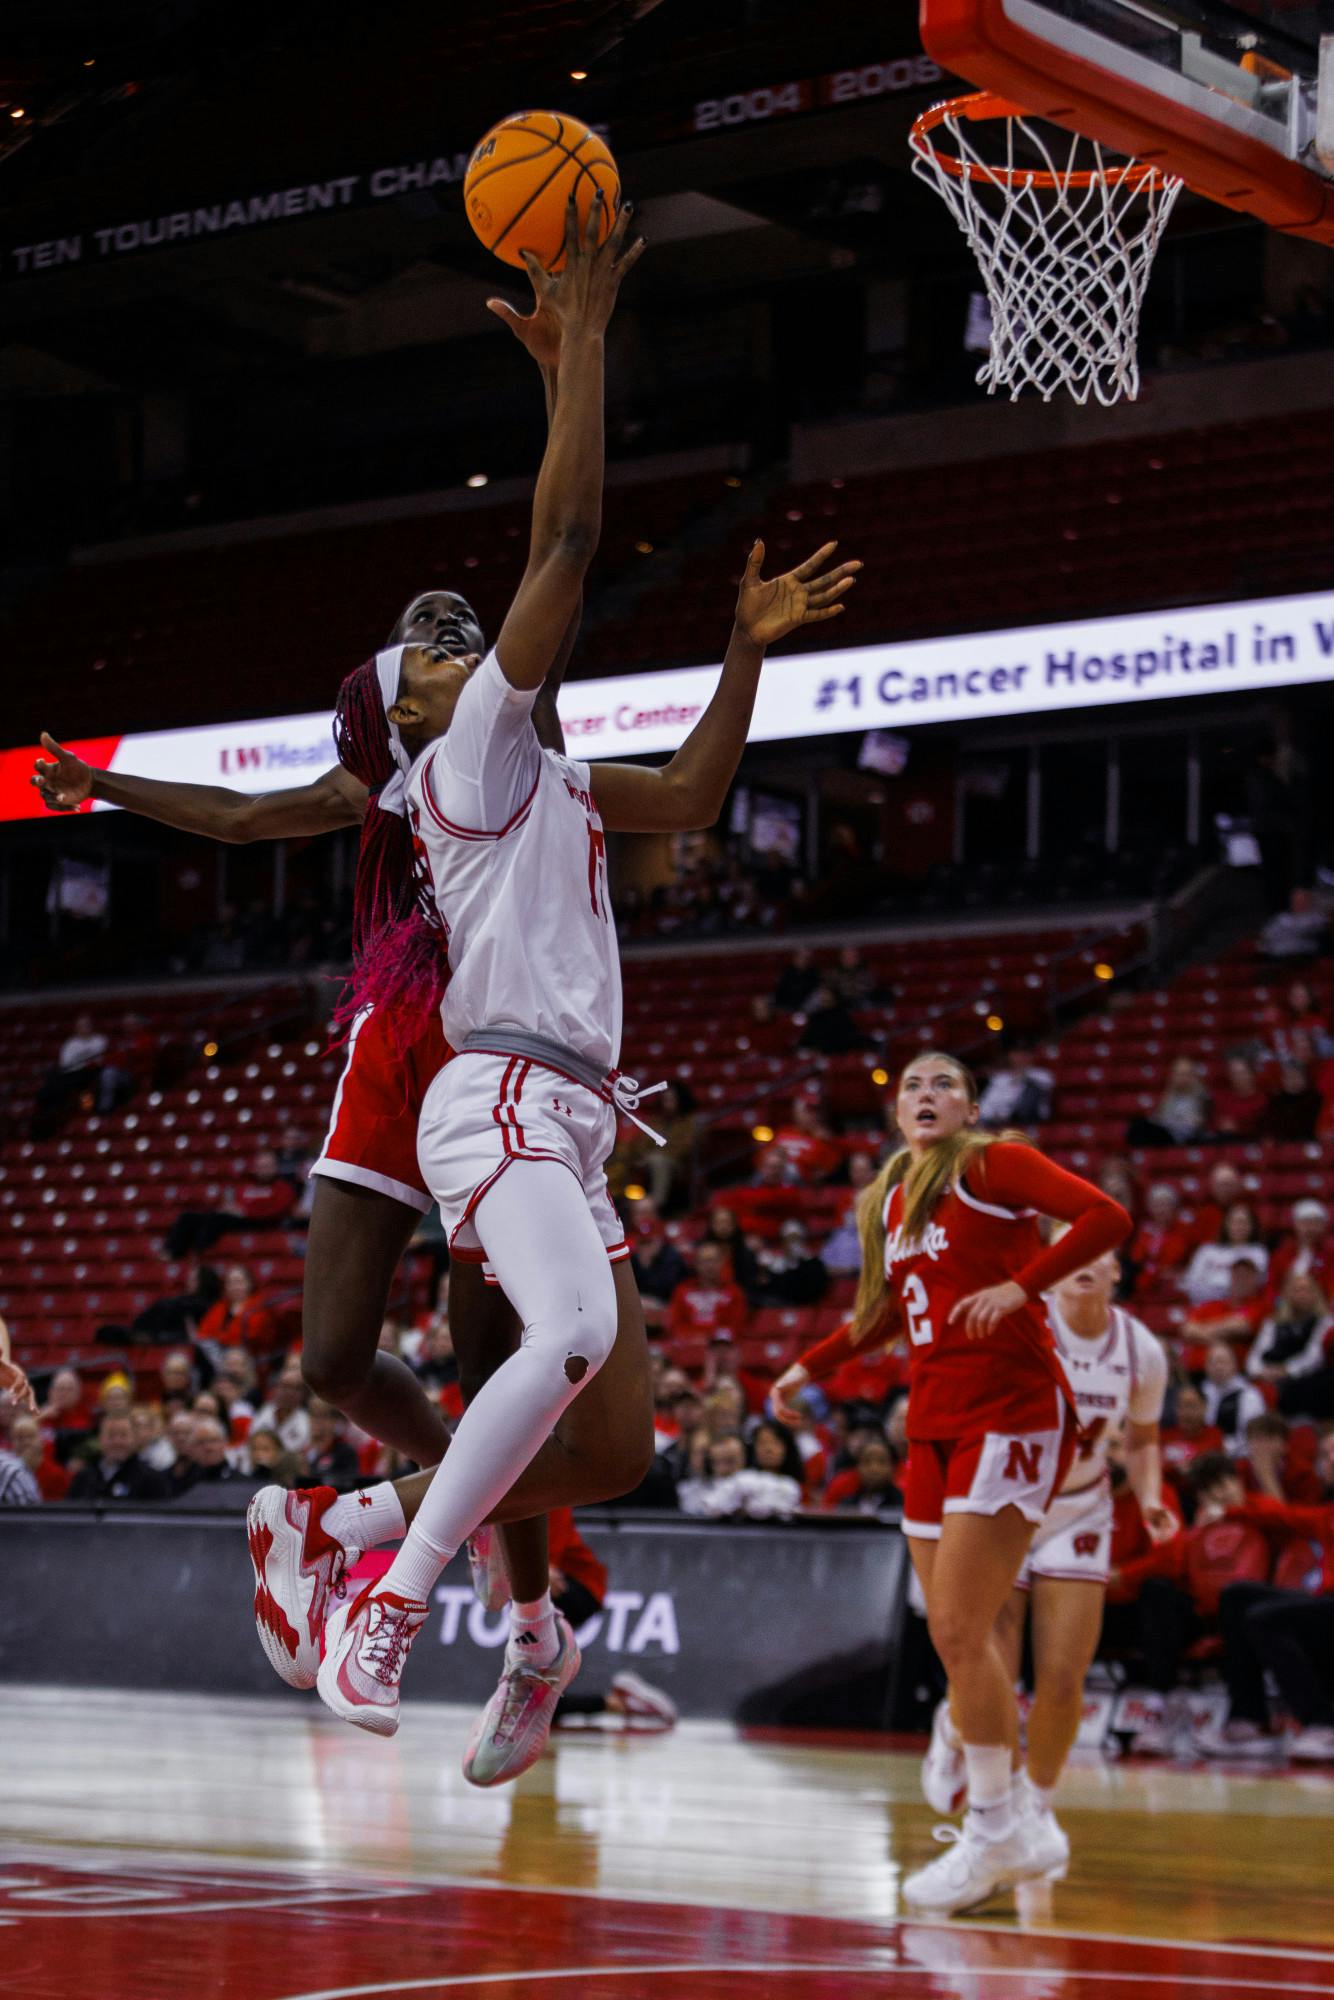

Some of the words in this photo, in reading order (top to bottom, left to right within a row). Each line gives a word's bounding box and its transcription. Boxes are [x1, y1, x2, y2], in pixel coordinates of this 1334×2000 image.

[693, 81, 801, 133] 2004
[10, 236, 82, 273] TEN
[93, 176, 361, 256] TOURNAMENT
[813, 675, 862, 713] #1
[877, 664, 1030, 705] Cancer
[1045, 630, 1237, 688] Hospital
[1253, 622, 1296, 665] in
[613, 704, 702, 732] Center
[901, 1273, 933, 1346] 2
[1002, 1440, 1044, 1483] N
[436, 1585, 680, 1654] TOTA
